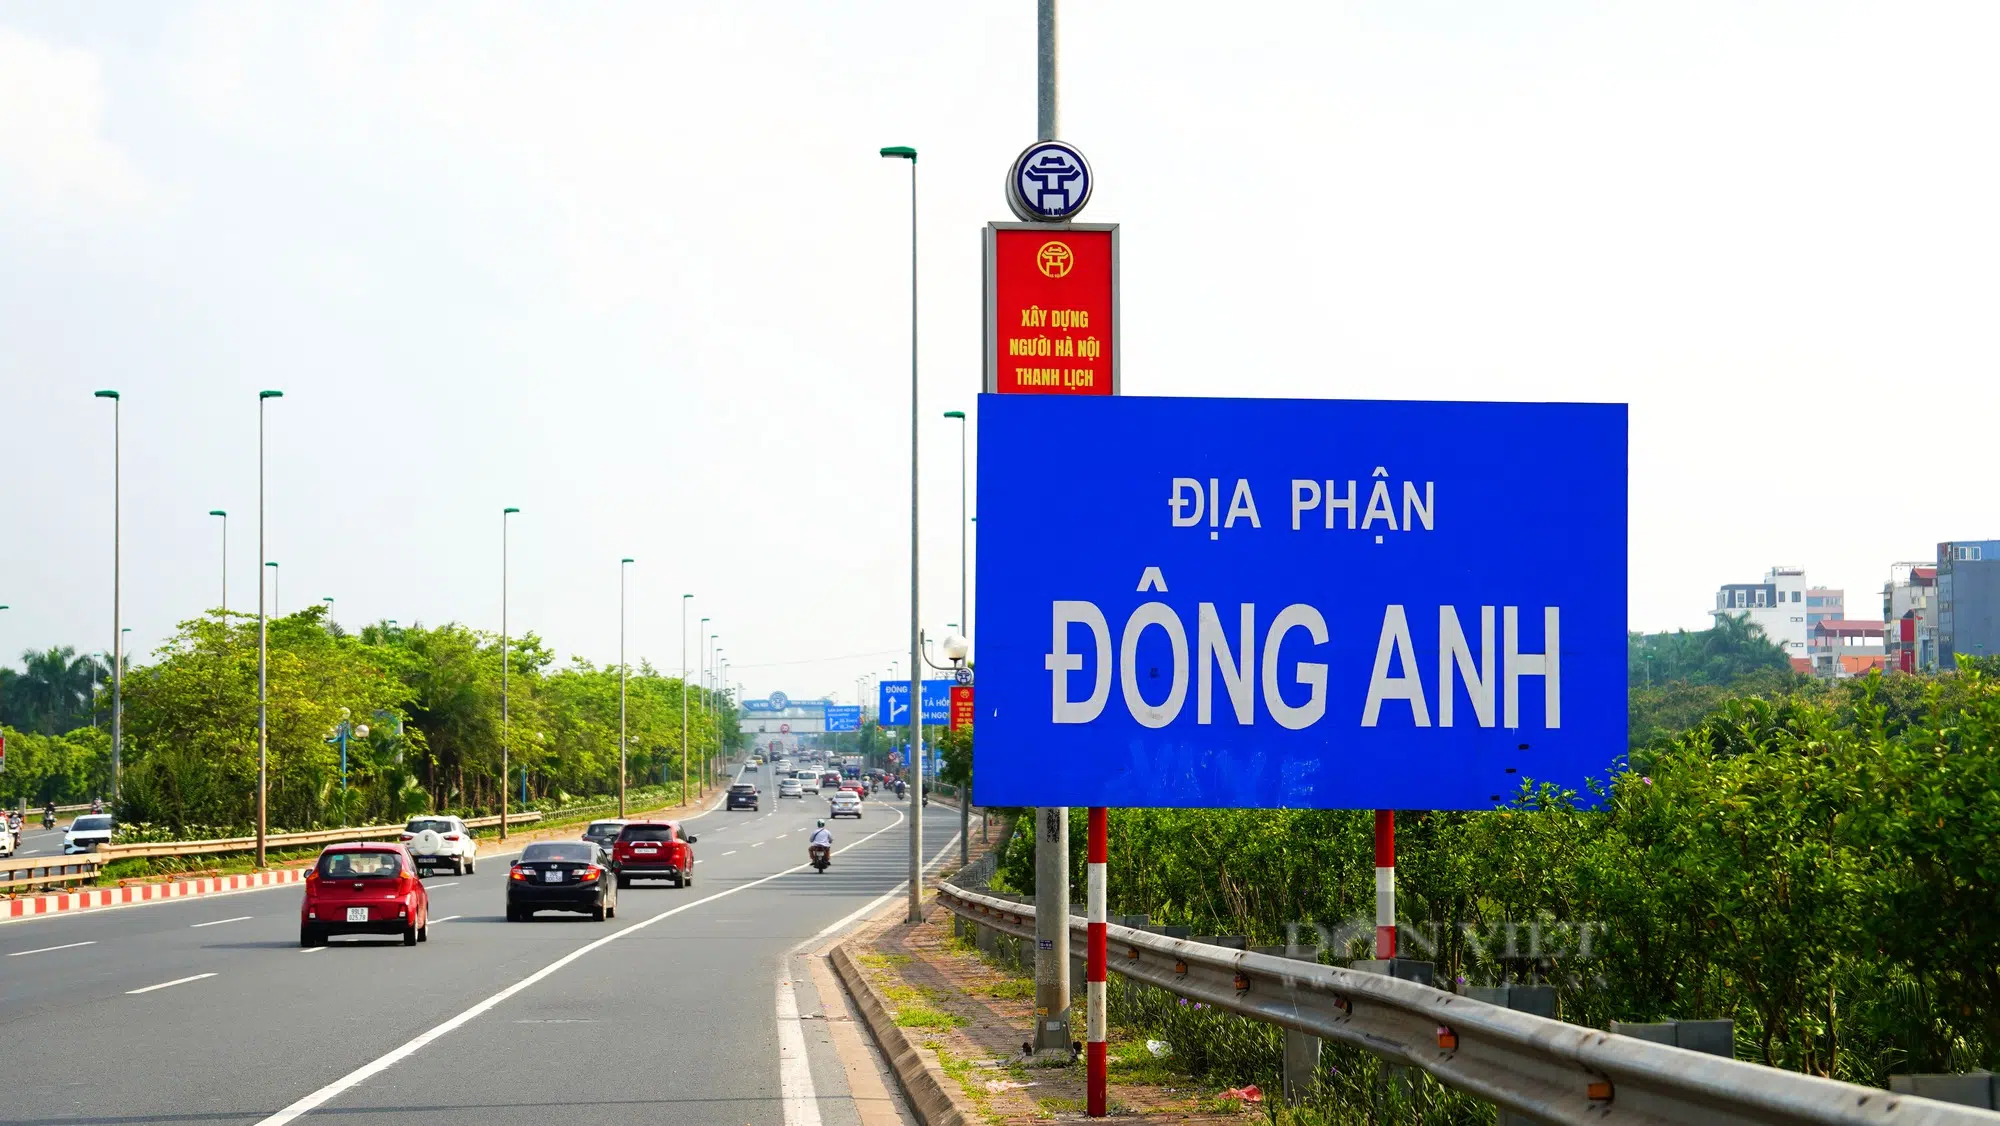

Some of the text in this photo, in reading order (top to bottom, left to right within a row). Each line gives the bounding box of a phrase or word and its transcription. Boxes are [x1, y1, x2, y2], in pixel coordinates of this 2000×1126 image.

[1021, 305, 1089, 331] XÂY DỰNG
[1009, 334, 1100, 361] NGƯỜI HÀ NỘI
[1015, 368, 1094, 390] THANH LỊCH
[1168, 466, 1435, 544] ĐỊA PHẬN
[1045, 566, 1560, 730] ĐÔNG ANH
[885, 685, 908, 694] ĐÔNG
